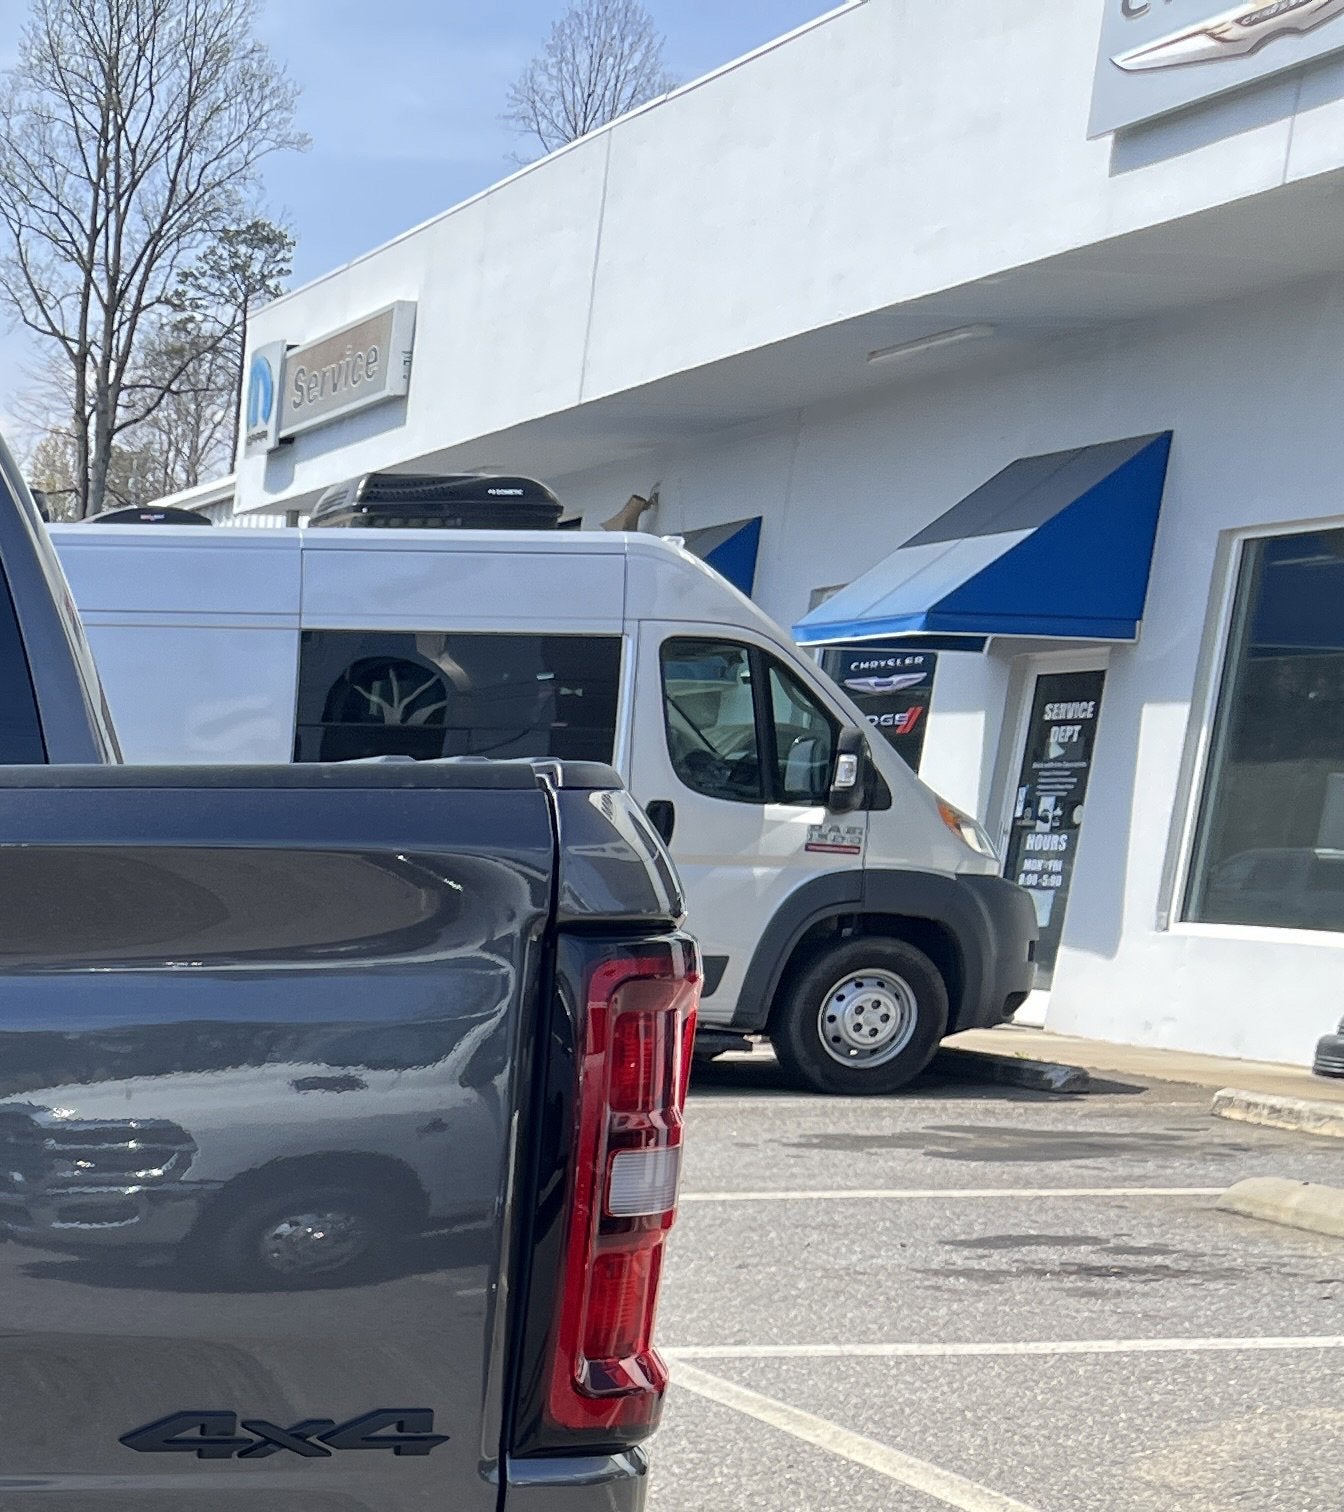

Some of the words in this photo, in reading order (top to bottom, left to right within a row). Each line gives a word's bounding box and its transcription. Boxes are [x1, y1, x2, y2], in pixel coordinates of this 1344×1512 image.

[292, 344, 379, 412] Service
[850, 655, 924, 672] CHRYSLER
[864, 712, 910, 727] DGE
[1043, 700, 1096, 721] SERVICE
[1049, 725, 1082, 743] DEPT
[1025, 833, 1068, 851] HOURS
[118, 1408, 450, 1459] 4x4
